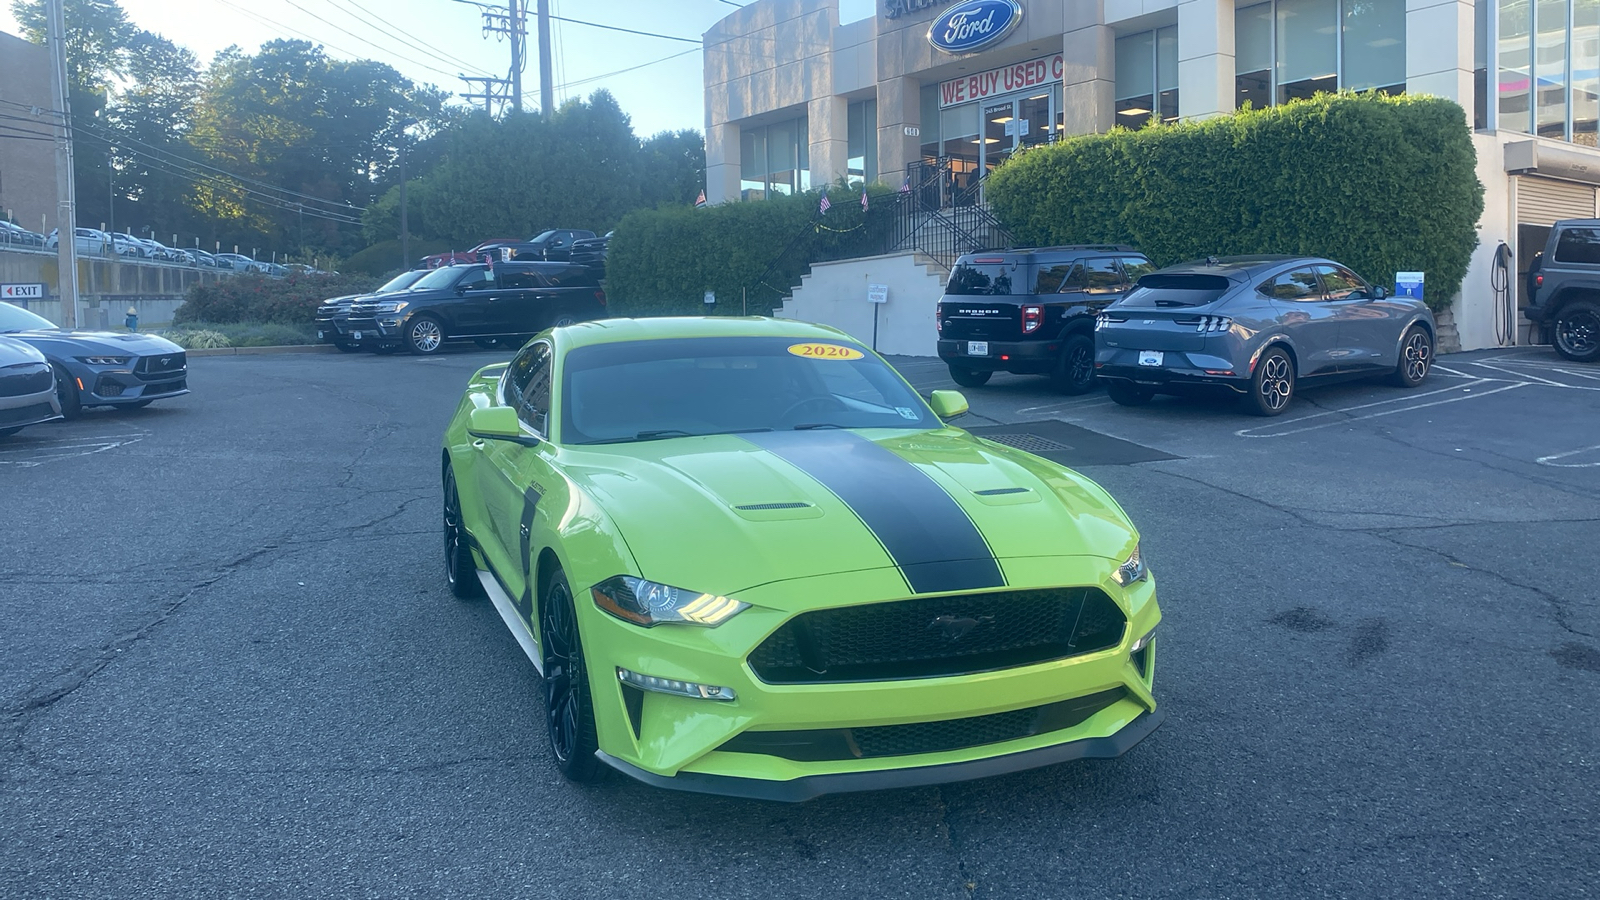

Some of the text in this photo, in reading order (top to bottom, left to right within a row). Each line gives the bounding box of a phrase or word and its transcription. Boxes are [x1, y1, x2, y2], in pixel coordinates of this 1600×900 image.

[944, 7, 995, 44] Ford
[942, 79, 965, 104] WE
[969, 70, 999, 99] BUY
[1004, 60, 1047, 91] USED
[15, 286, 37, 296] EXIT
[802, 345, 850, 357] 2020
[531, 480, 547, 495] MUSTANG
